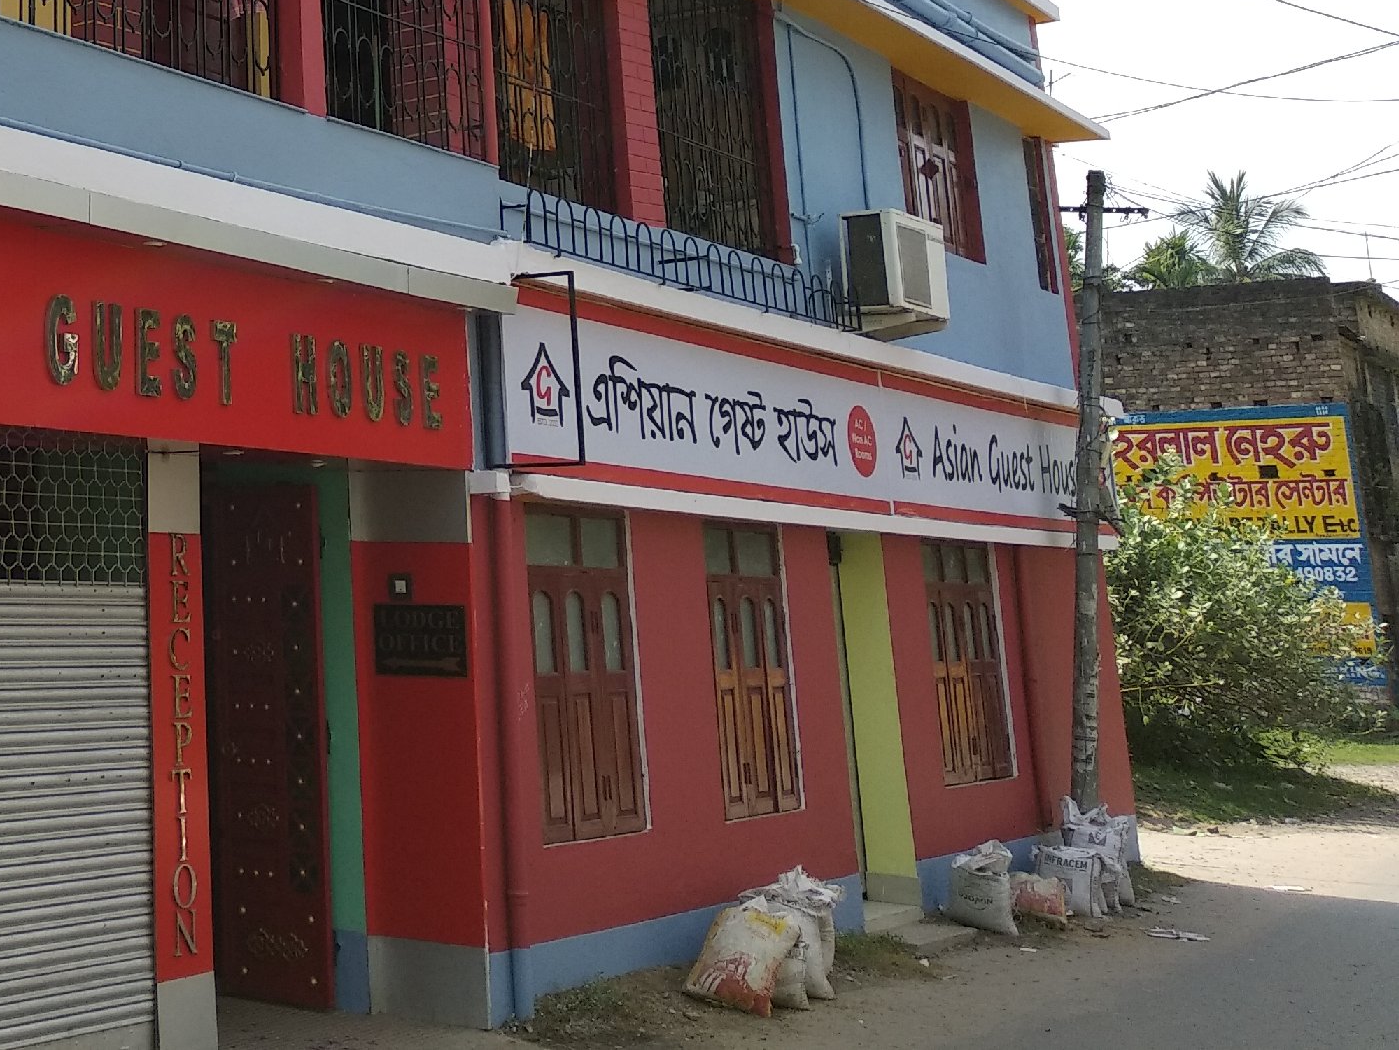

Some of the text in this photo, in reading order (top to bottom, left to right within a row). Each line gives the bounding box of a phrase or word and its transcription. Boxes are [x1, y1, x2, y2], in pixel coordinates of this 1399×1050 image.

[44, 293, 237, 406] GUEST
[290, 333, 443, 429] HOUSE
[586, 355, 697, 444] এশিয়ান
[773, 398, 838, 467] হাউস
[933, 424, 982, 483] Asian
[988, 434, 1035, 494] Guest
[1039, 444, 1078, 497] Hous
[1274, 472, 1348, 509] সেন্টার
[379, 633, 461, 653] OFFICE
[168, 532, 198, 957] RECEPTION
